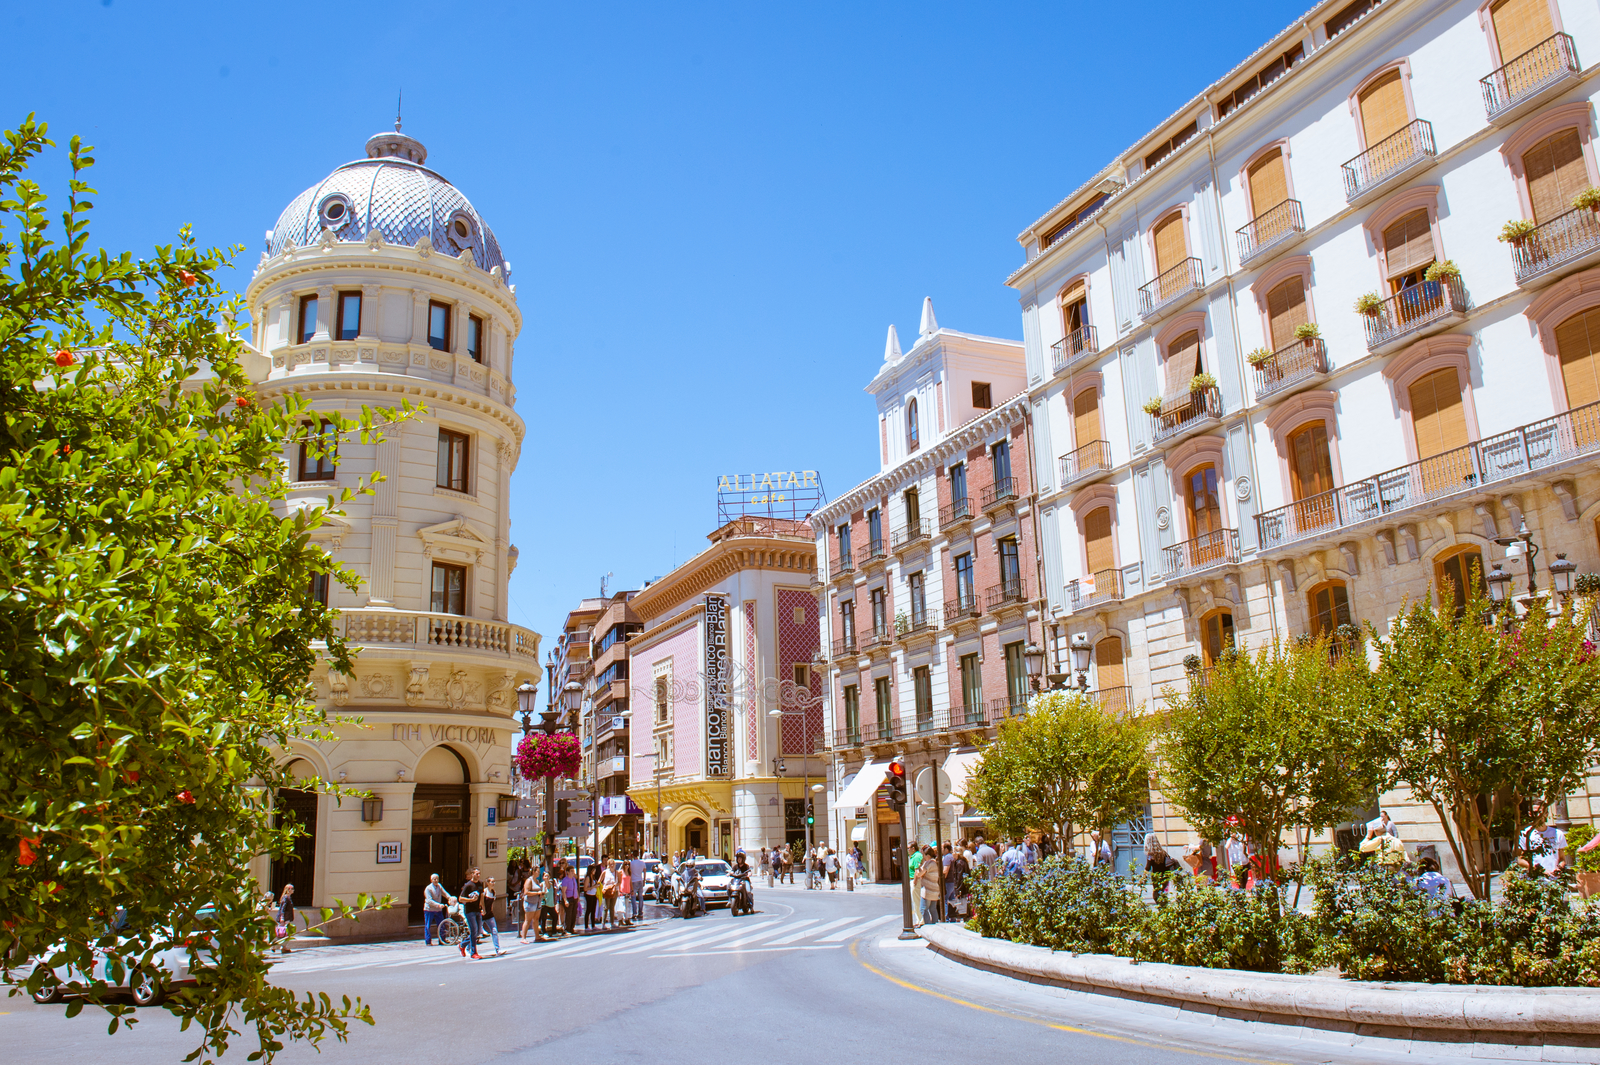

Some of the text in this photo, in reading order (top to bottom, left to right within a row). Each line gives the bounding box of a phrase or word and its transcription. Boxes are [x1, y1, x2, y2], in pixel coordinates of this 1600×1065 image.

[718, 470, 819, 492] ALIATAR
[751, 493, 785, 504] cafe
[707, 645, 716, 685] Blanco
[429, 725, 496, 744] VICTORIA
[708, 713, 720, 774] Blanco
